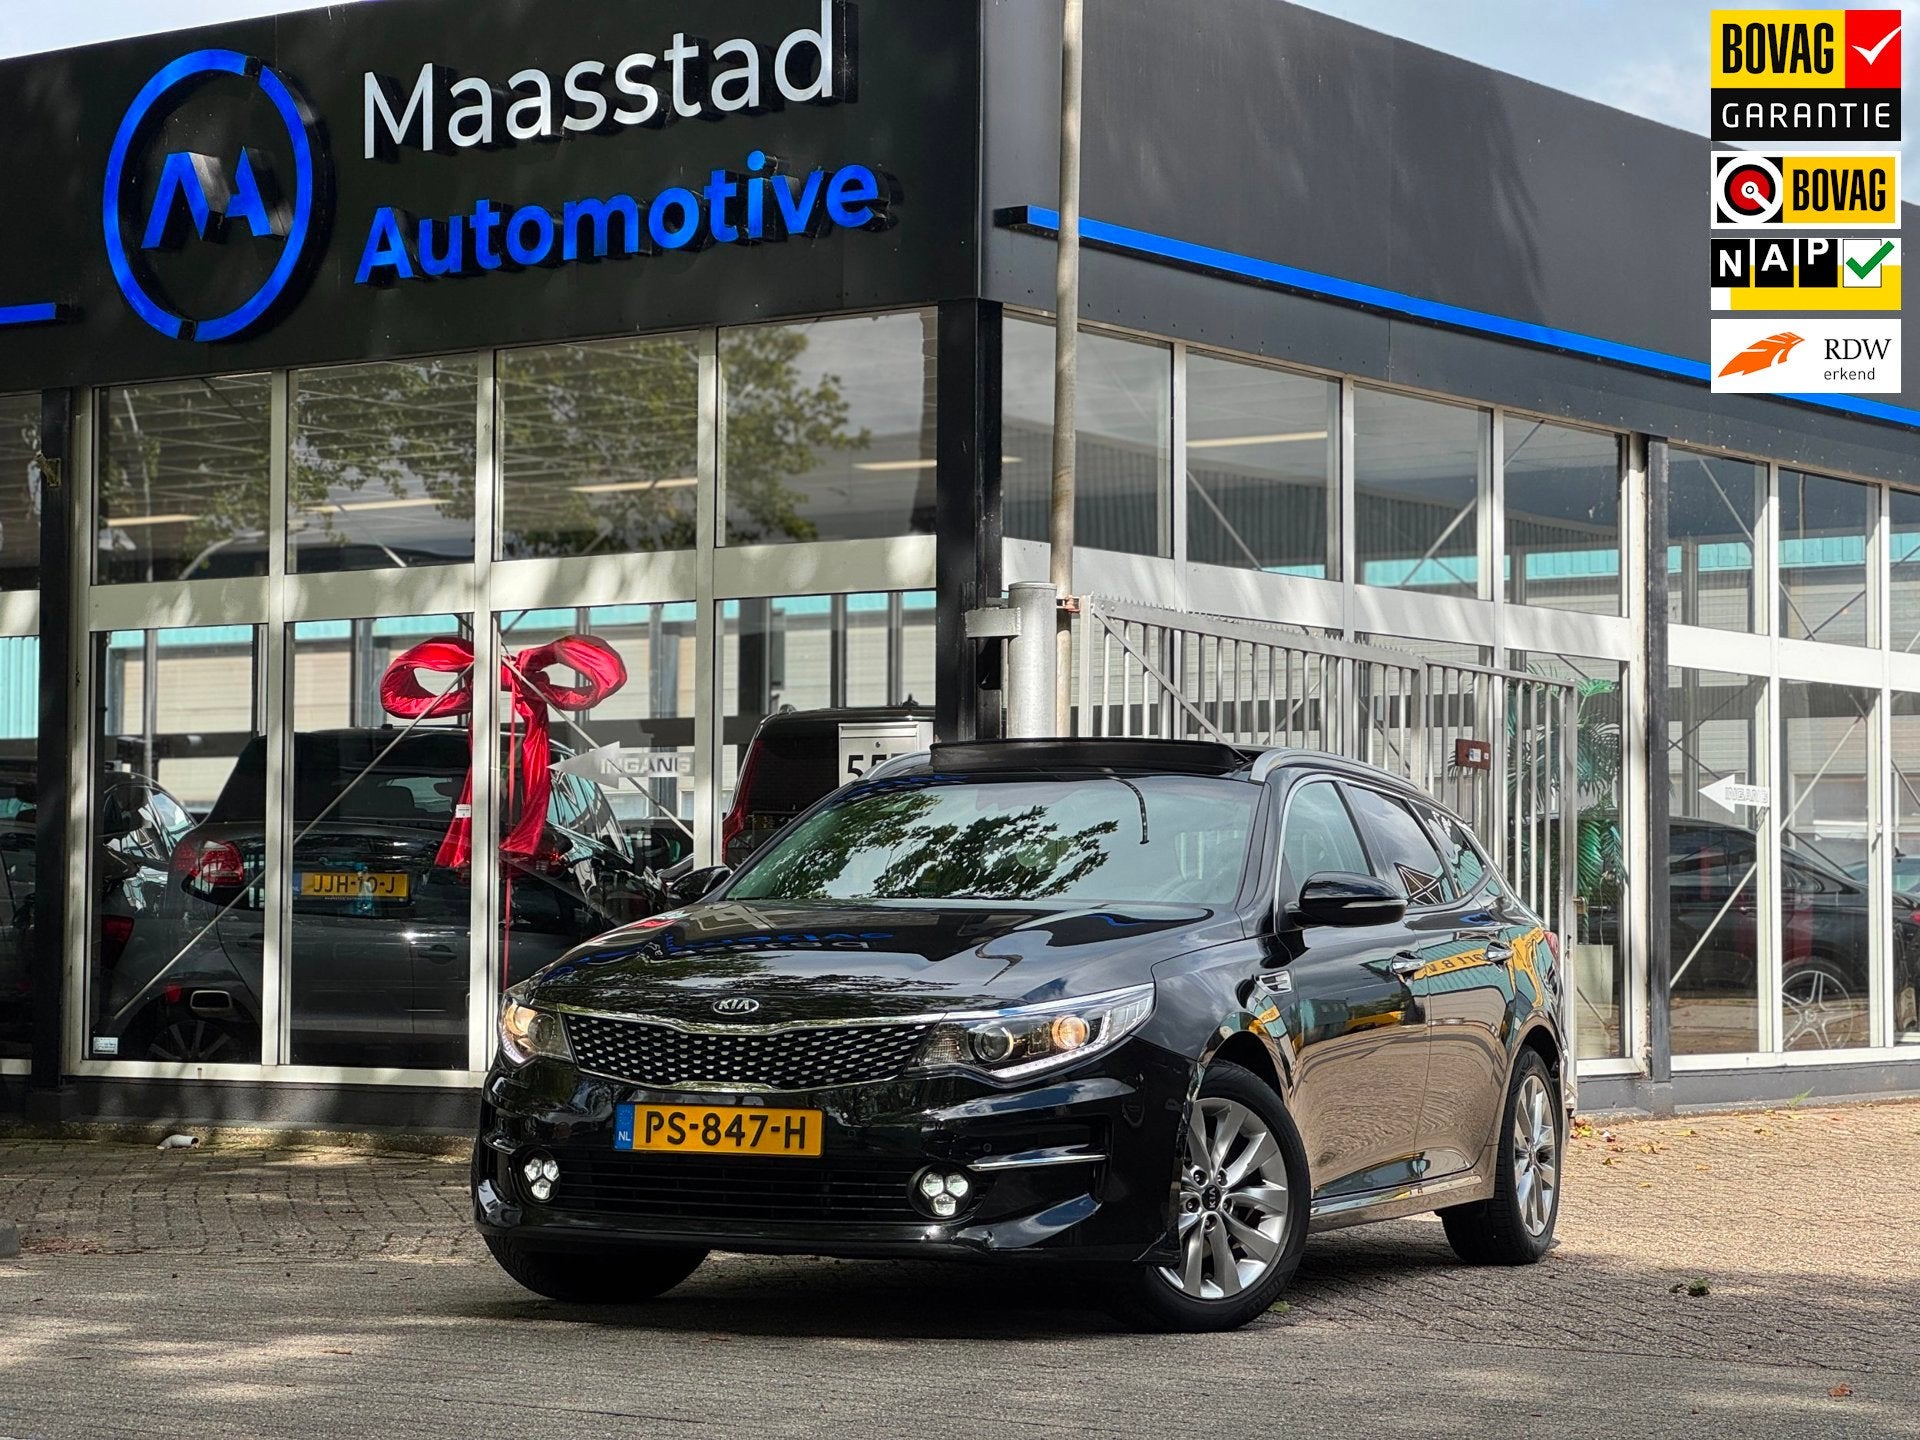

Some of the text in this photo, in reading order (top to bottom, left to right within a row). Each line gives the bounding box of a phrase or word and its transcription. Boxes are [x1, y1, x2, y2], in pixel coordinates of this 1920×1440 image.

[364, 0, 833, 158] Maasstad
[355, 150, 879, 284] Automotive
[600, 757, 691, 775] INGANG
[718, 999, 750, 1010] KIA
[618, 1110, 807, 1150] NL PS-847-H
